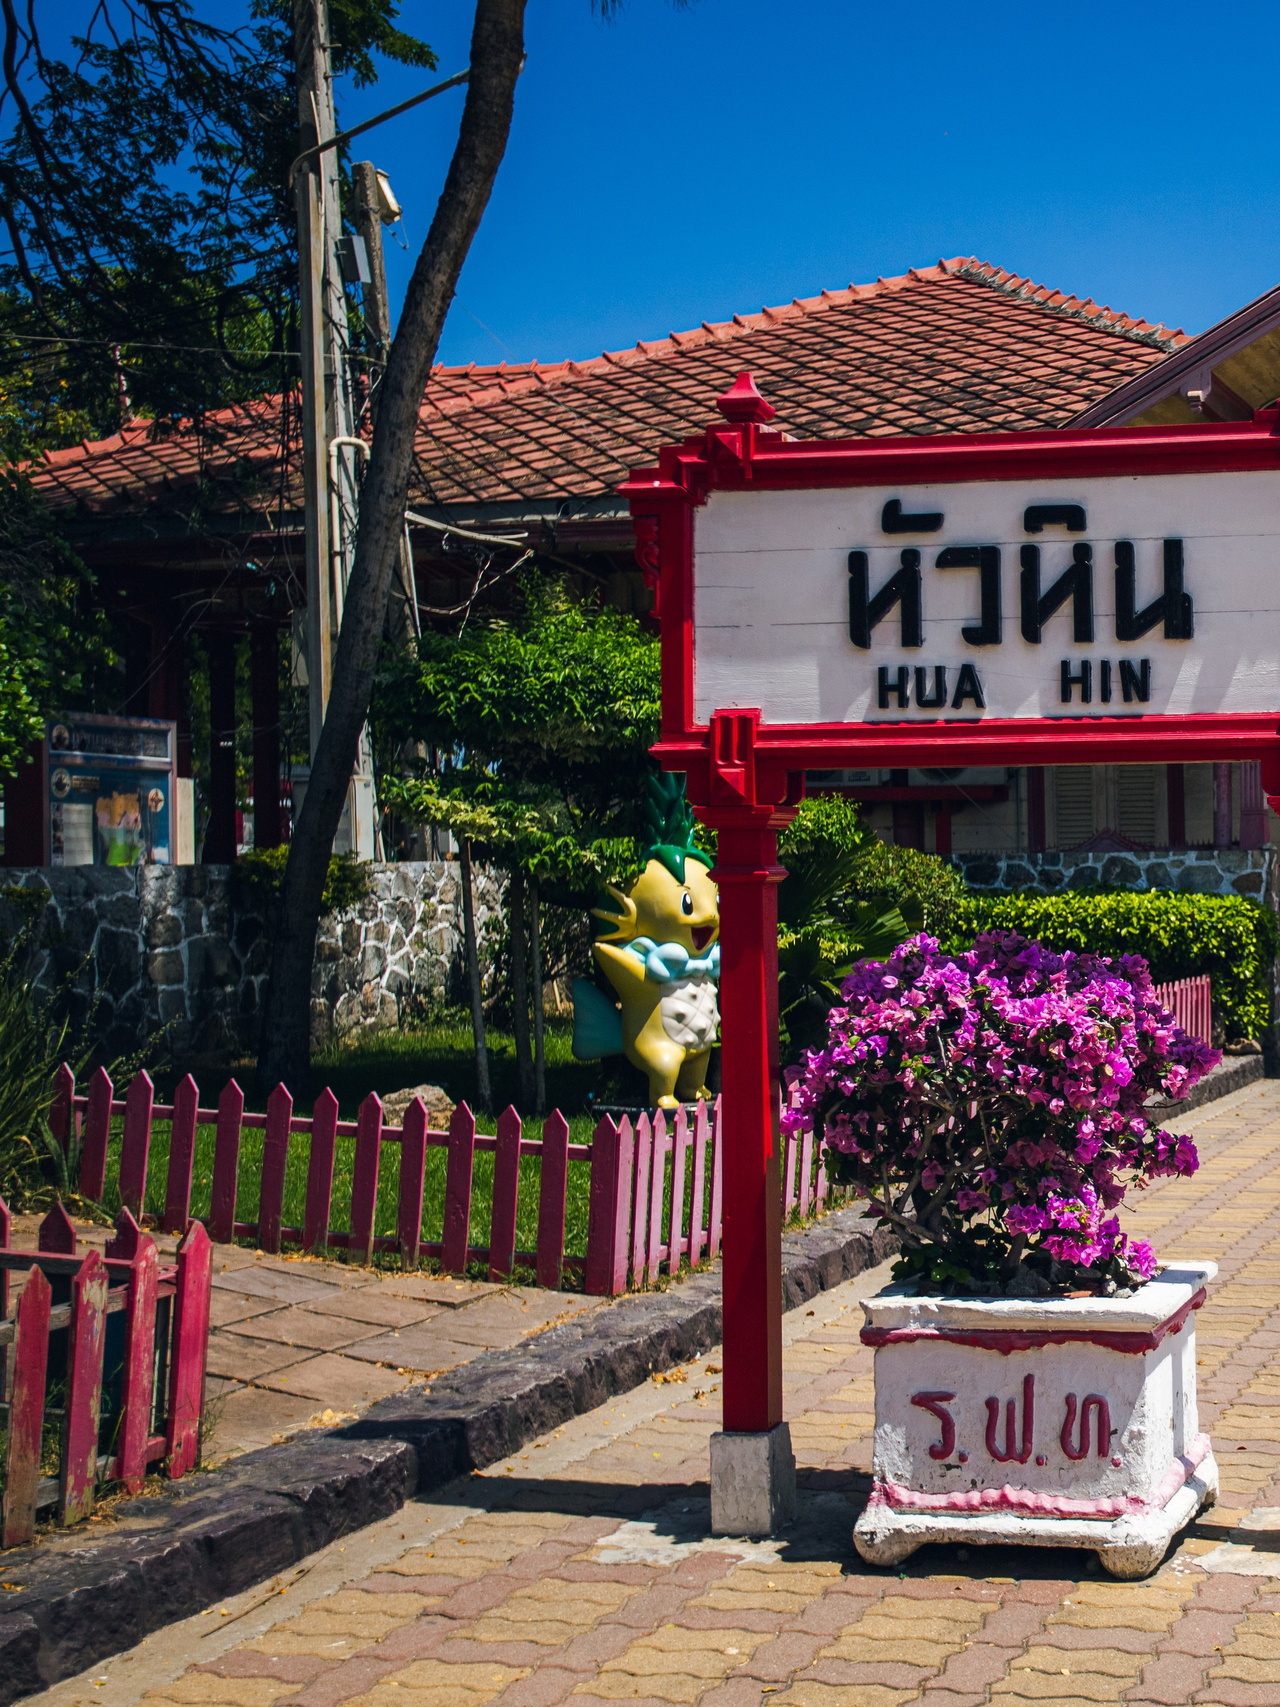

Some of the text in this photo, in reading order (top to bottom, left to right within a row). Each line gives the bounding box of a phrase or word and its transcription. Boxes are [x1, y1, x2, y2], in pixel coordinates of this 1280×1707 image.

[847, 498, 1194, 650] หัวหิน
[877, 658, 1151, 710] HUA HIN
